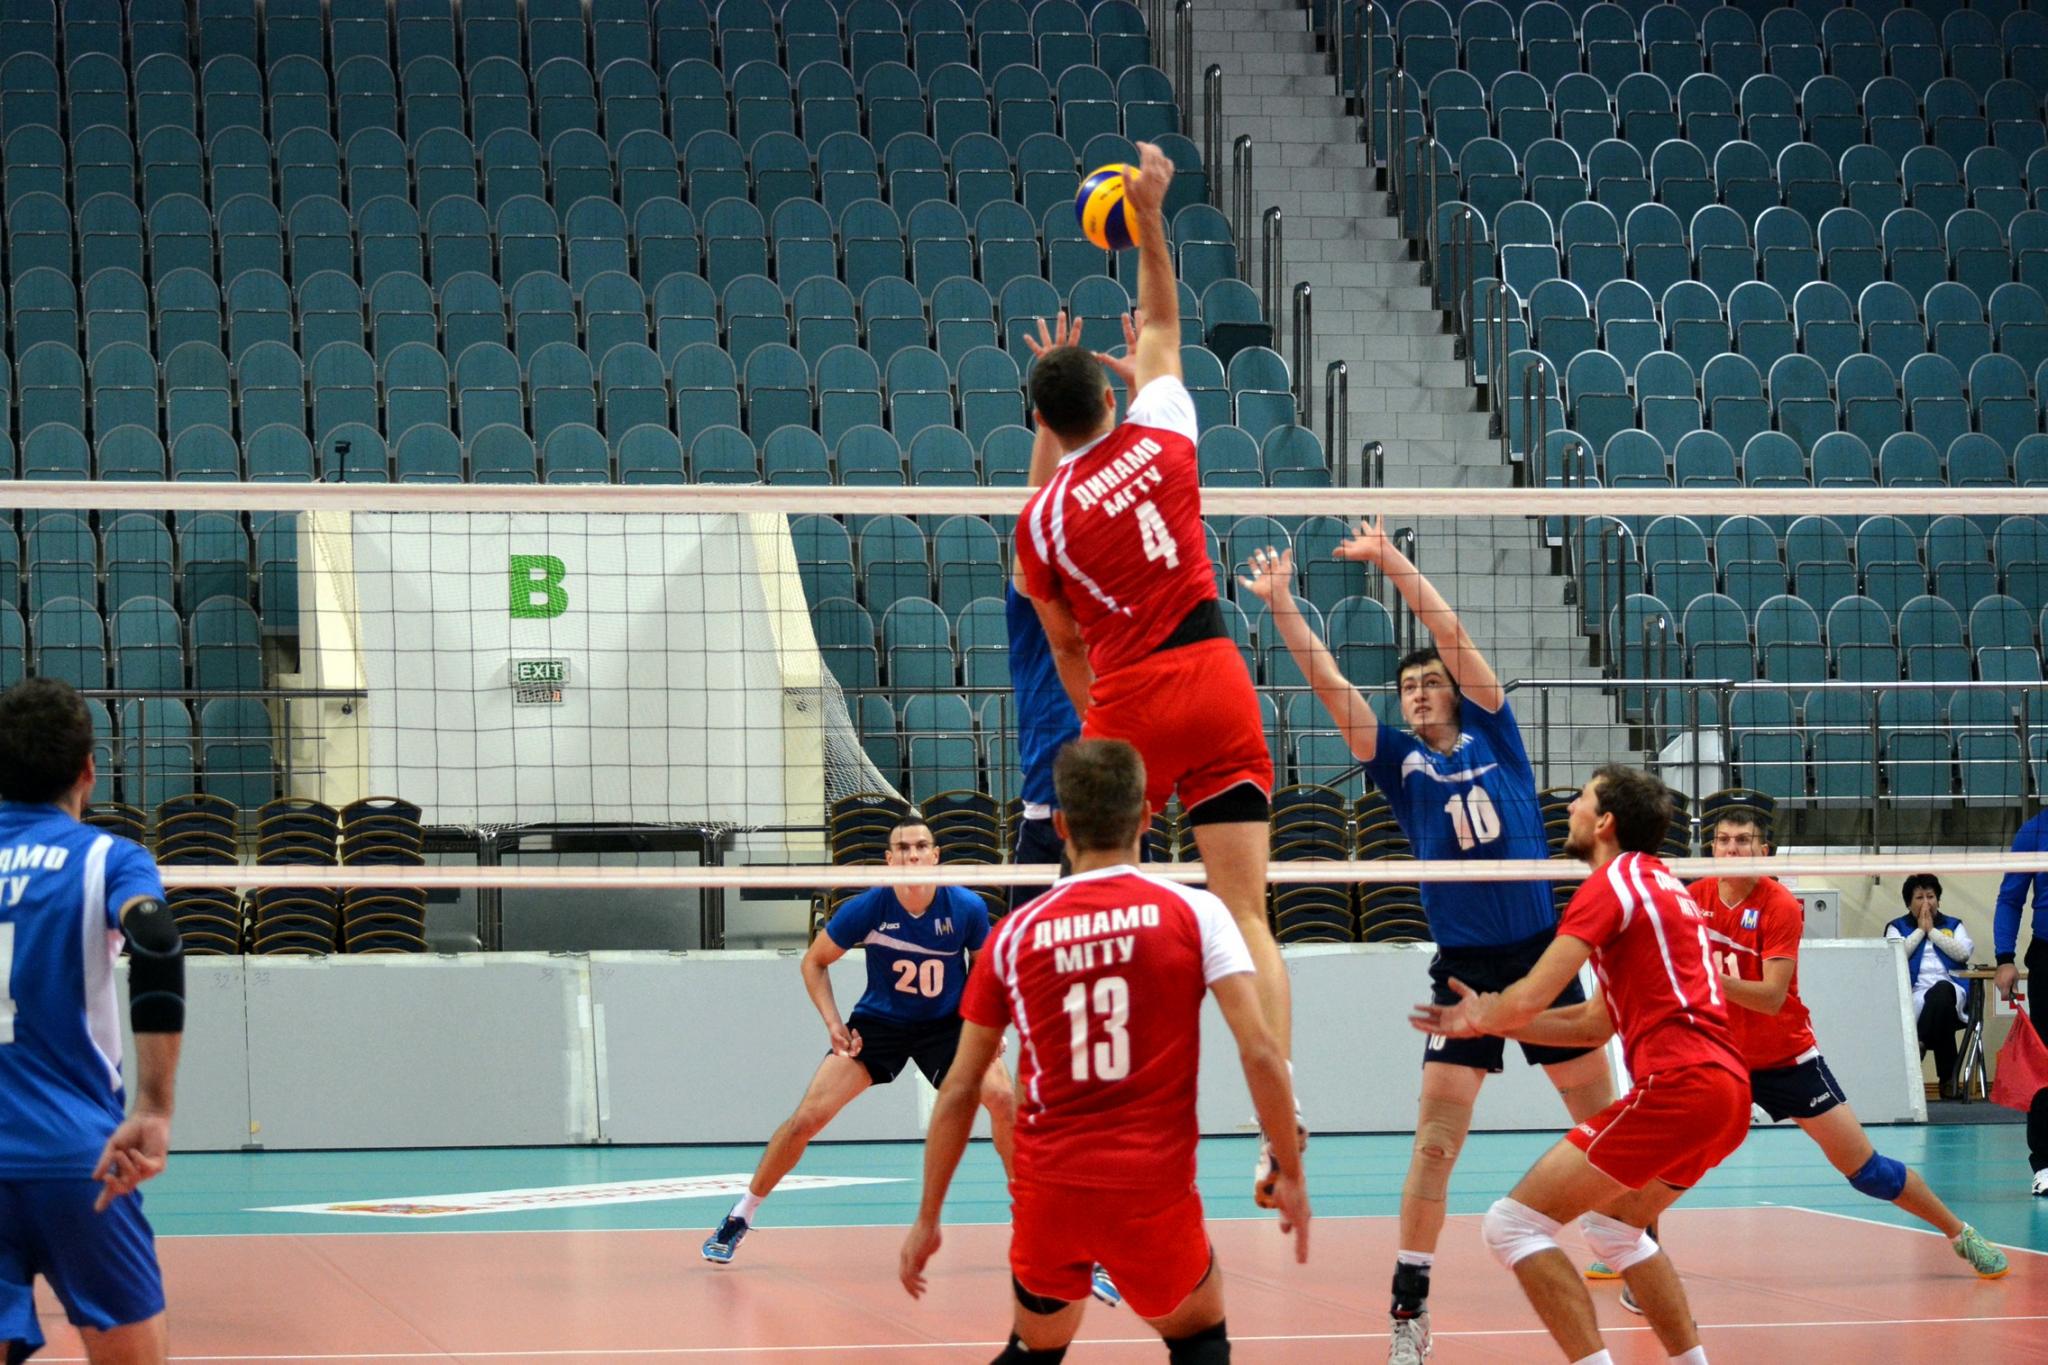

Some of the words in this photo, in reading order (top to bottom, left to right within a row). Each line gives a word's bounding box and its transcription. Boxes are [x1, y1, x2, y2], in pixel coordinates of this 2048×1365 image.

[1071, 437, 1162, 511] ДИНАМО
[1102, 465, 1162, 517] МГТУ
[1135, 500, 1180, 570] 4
[511, 555, 569, 618] B
[519, 663, 562, 679] EXIT
[1444, 785, 1501, 851] 10
[1033, 903, 1160, 951] ДИНАМО
[1054, 935, 1136, 974] МГТУ
[892, 958, 945, 998] 20
[1063, 976, 1130, 1081] 13
